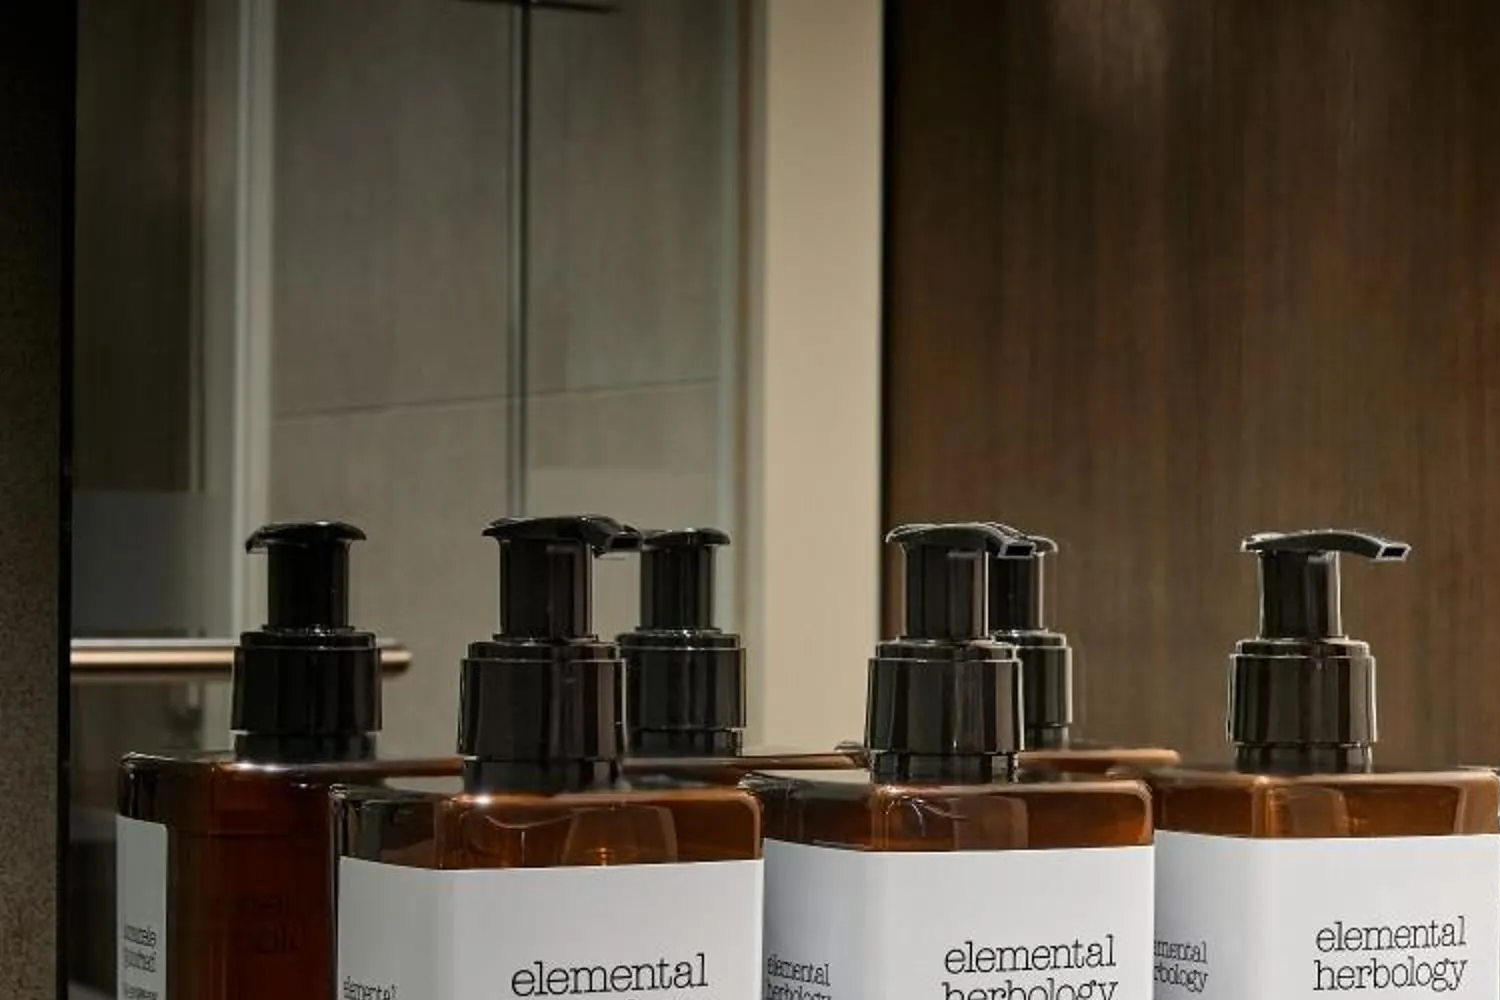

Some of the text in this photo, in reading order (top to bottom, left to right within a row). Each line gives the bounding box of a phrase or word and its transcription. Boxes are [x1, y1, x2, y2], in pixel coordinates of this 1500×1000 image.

[1154, 939, 1208, 965] mental
[1315, 915, 1468, 953] elemental
[767, 954, 832, 987] elemental
[943, 934, 1117, 974] elemental
[511, 952, 709, 997] elemental
[1154, 962, 1209, 993] rbology
[1312, 955, 1470, 993] herbology
